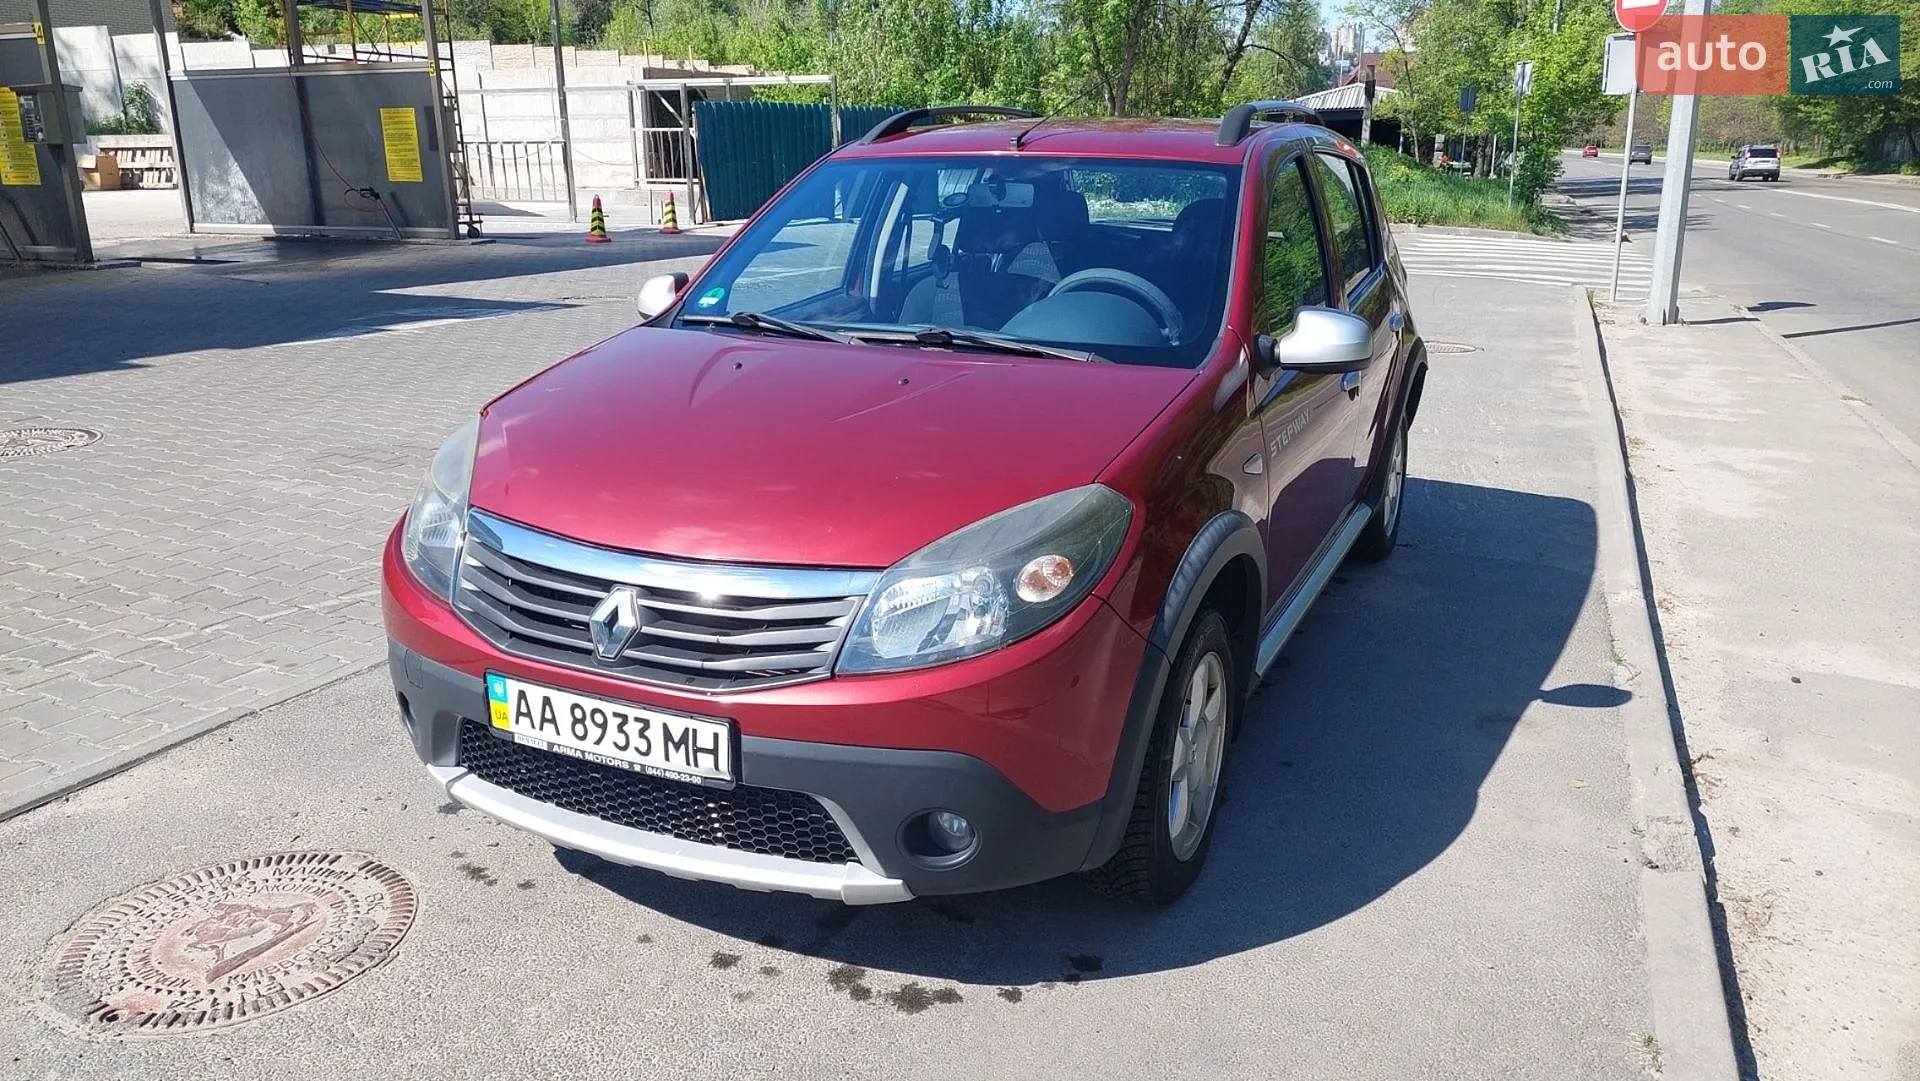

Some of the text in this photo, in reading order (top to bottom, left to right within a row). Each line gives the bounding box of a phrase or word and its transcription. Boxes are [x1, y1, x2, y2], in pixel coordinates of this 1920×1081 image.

[1269, 407, 1310, 458] STEPWAY
[494, 708, 509, 722] UA
[514, 689, 720, 772] AA 8933 MH
[552, 744, 583, 760] ARMA
[584, 752, 630, 770] MOTORS
